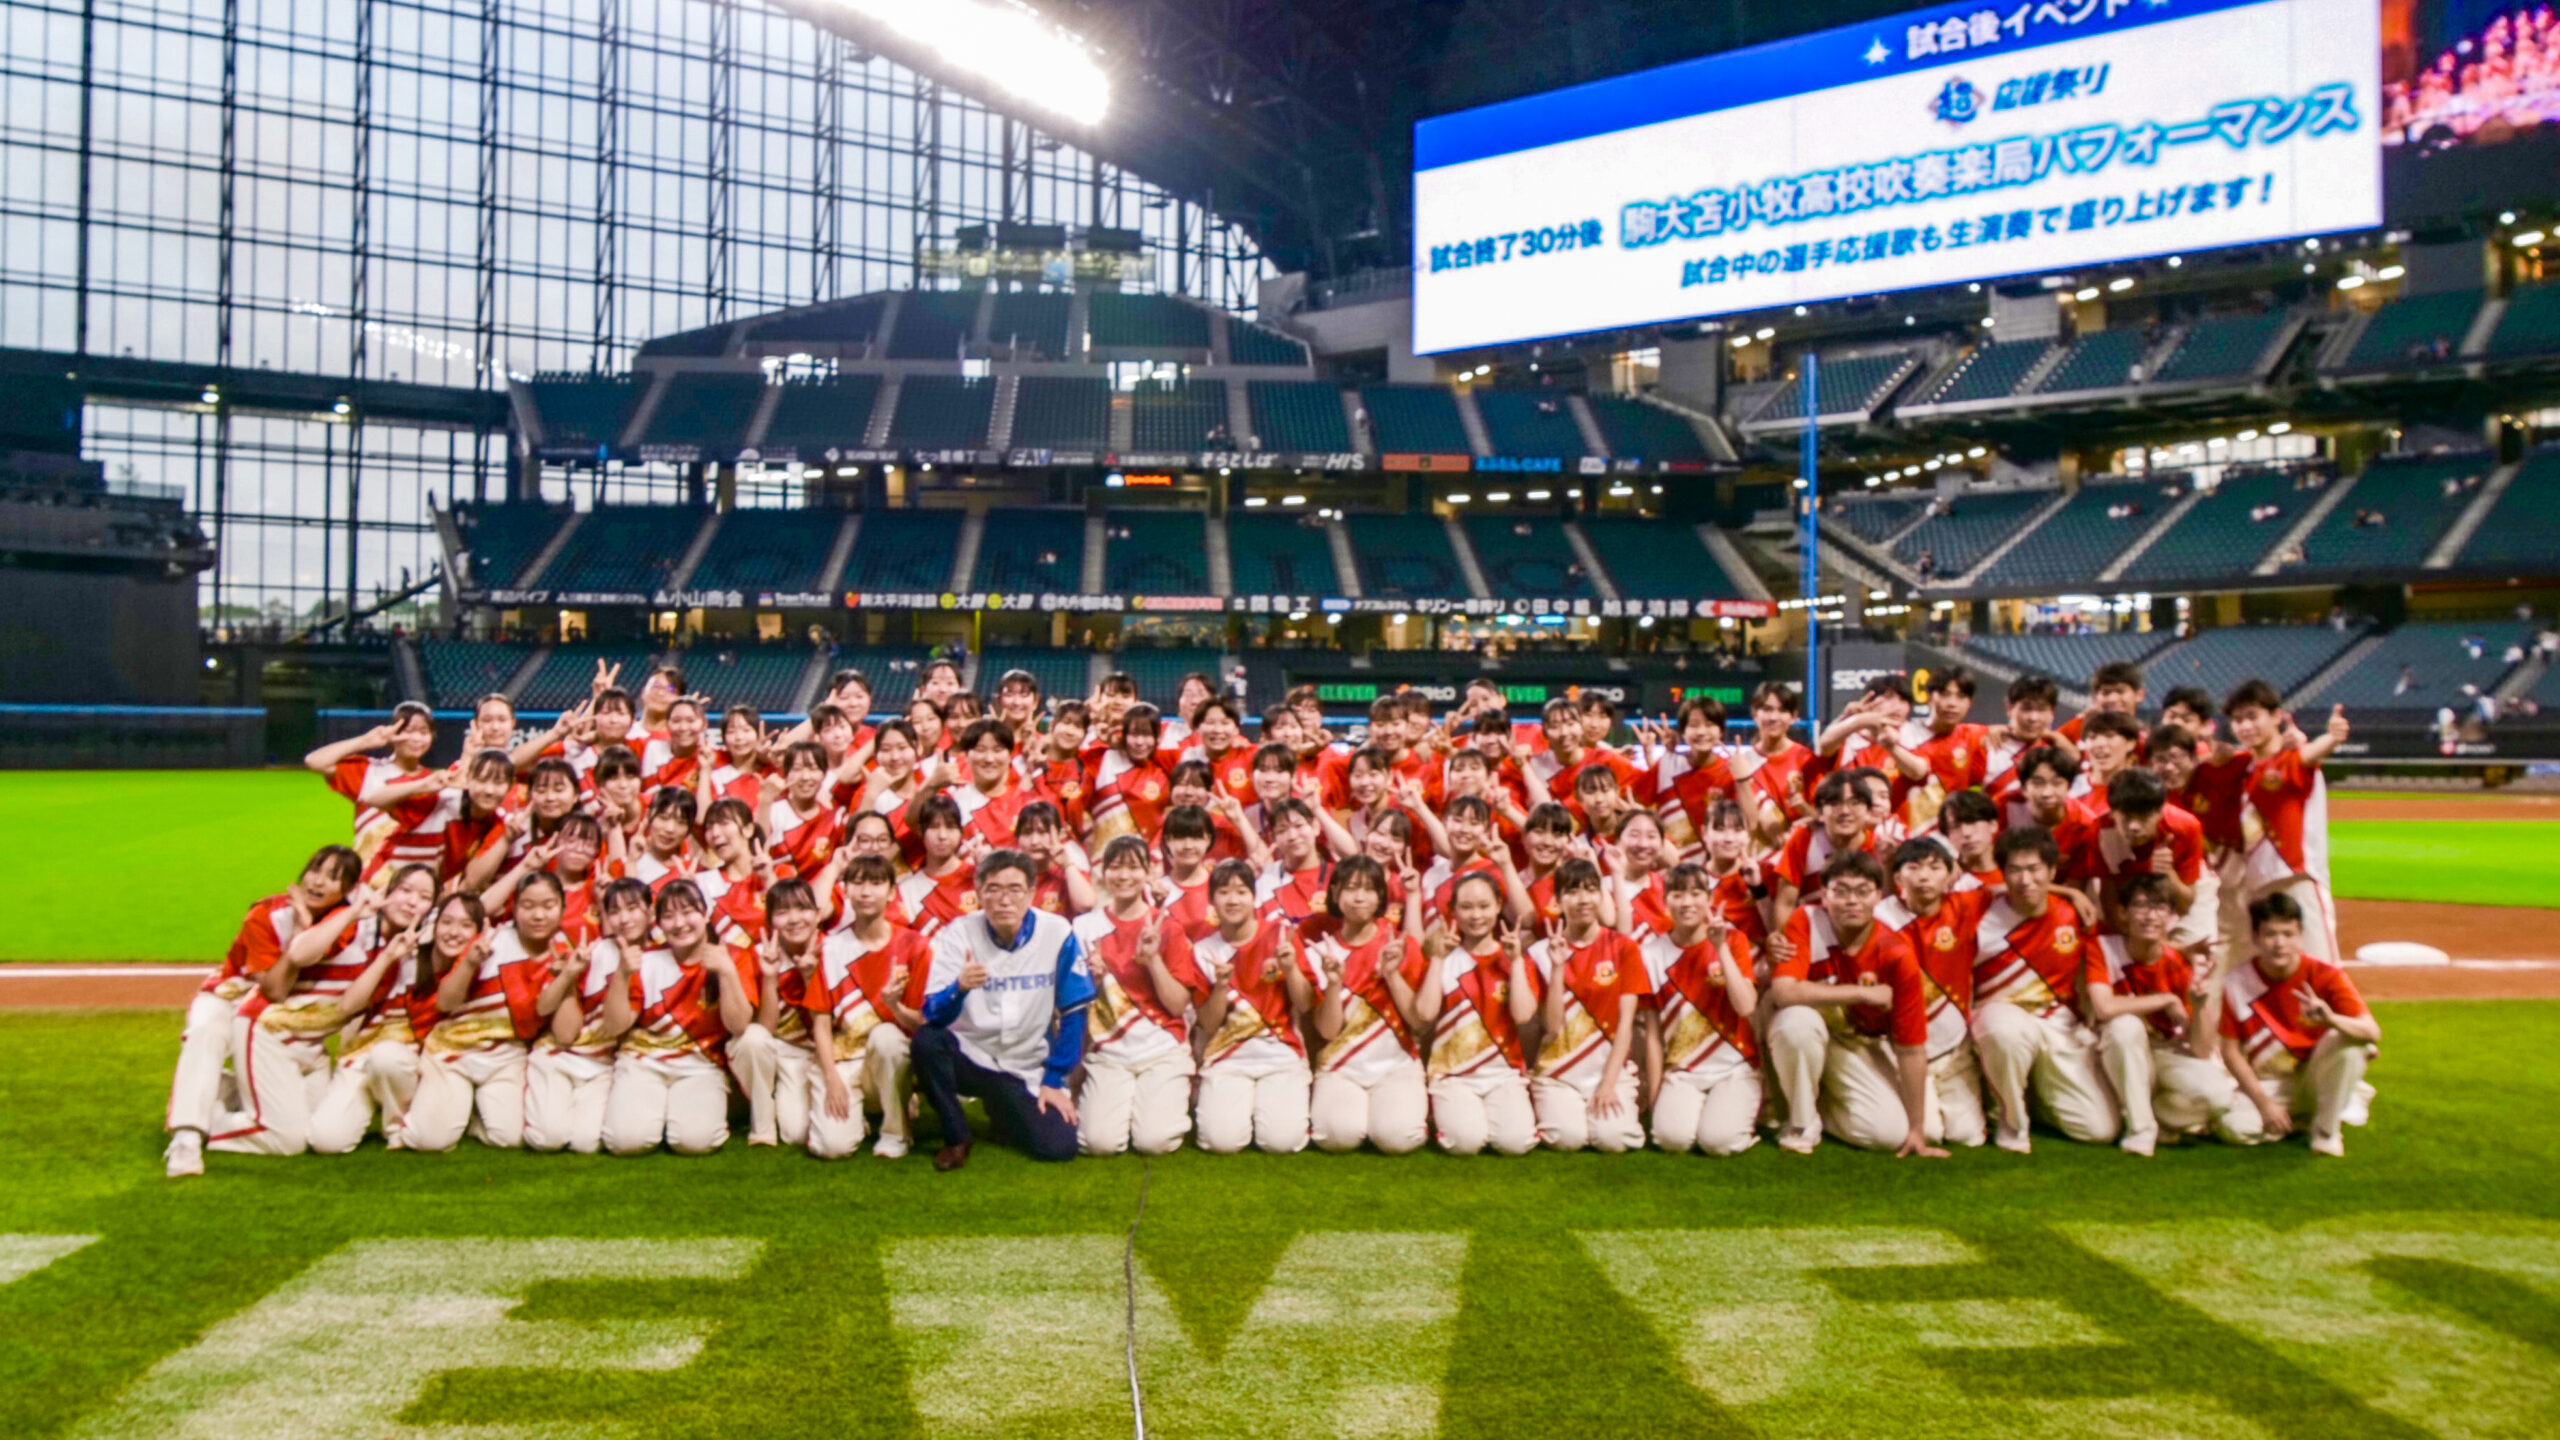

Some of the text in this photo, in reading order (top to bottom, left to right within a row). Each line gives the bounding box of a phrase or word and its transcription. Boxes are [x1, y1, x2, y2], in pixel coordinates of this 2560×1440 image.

[1906, 0, 2129, 58] 試合後イベント
[1992, 63, 2109, 111] 応援祭り
[1431, 82, 2357, 273] 試合終了30分後 駒大苫小牧高校吹奏楽局パフォーマンス
[983, 972, 1056, 991] GHTER
